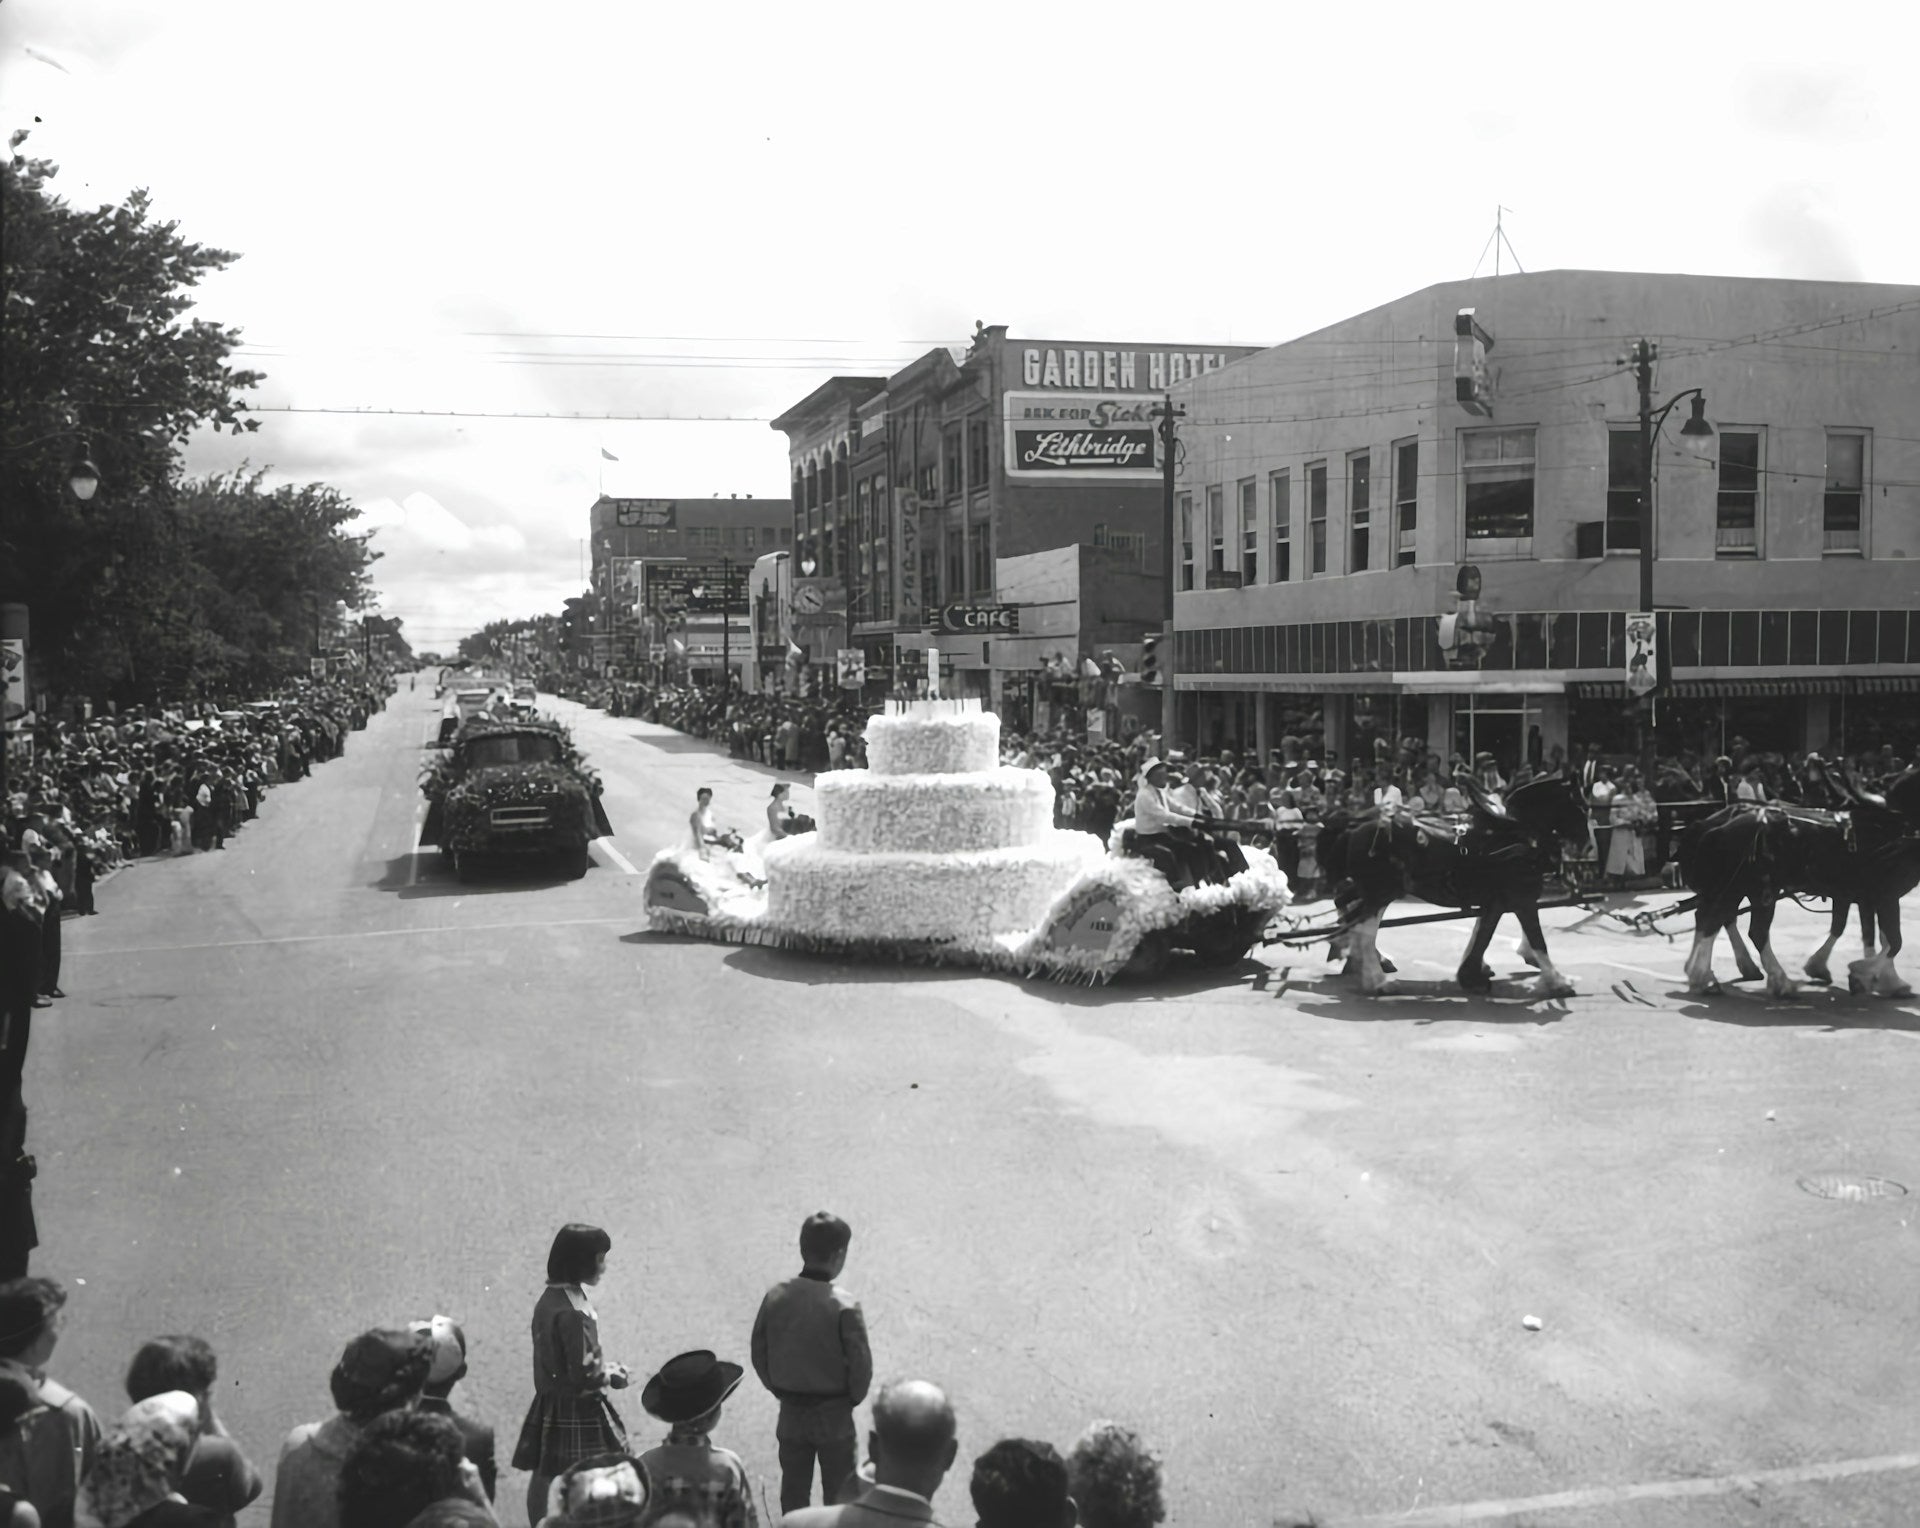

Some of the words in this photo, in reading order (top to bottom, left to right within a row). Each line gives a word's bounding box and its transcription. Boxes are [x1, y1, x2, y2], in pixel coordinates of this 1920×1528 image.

[1023, 349, 1136, 388] GARDEN
[1024, 431, 1147, 466] Lethbridge
[964, 610, 1011, 627] CAFE
